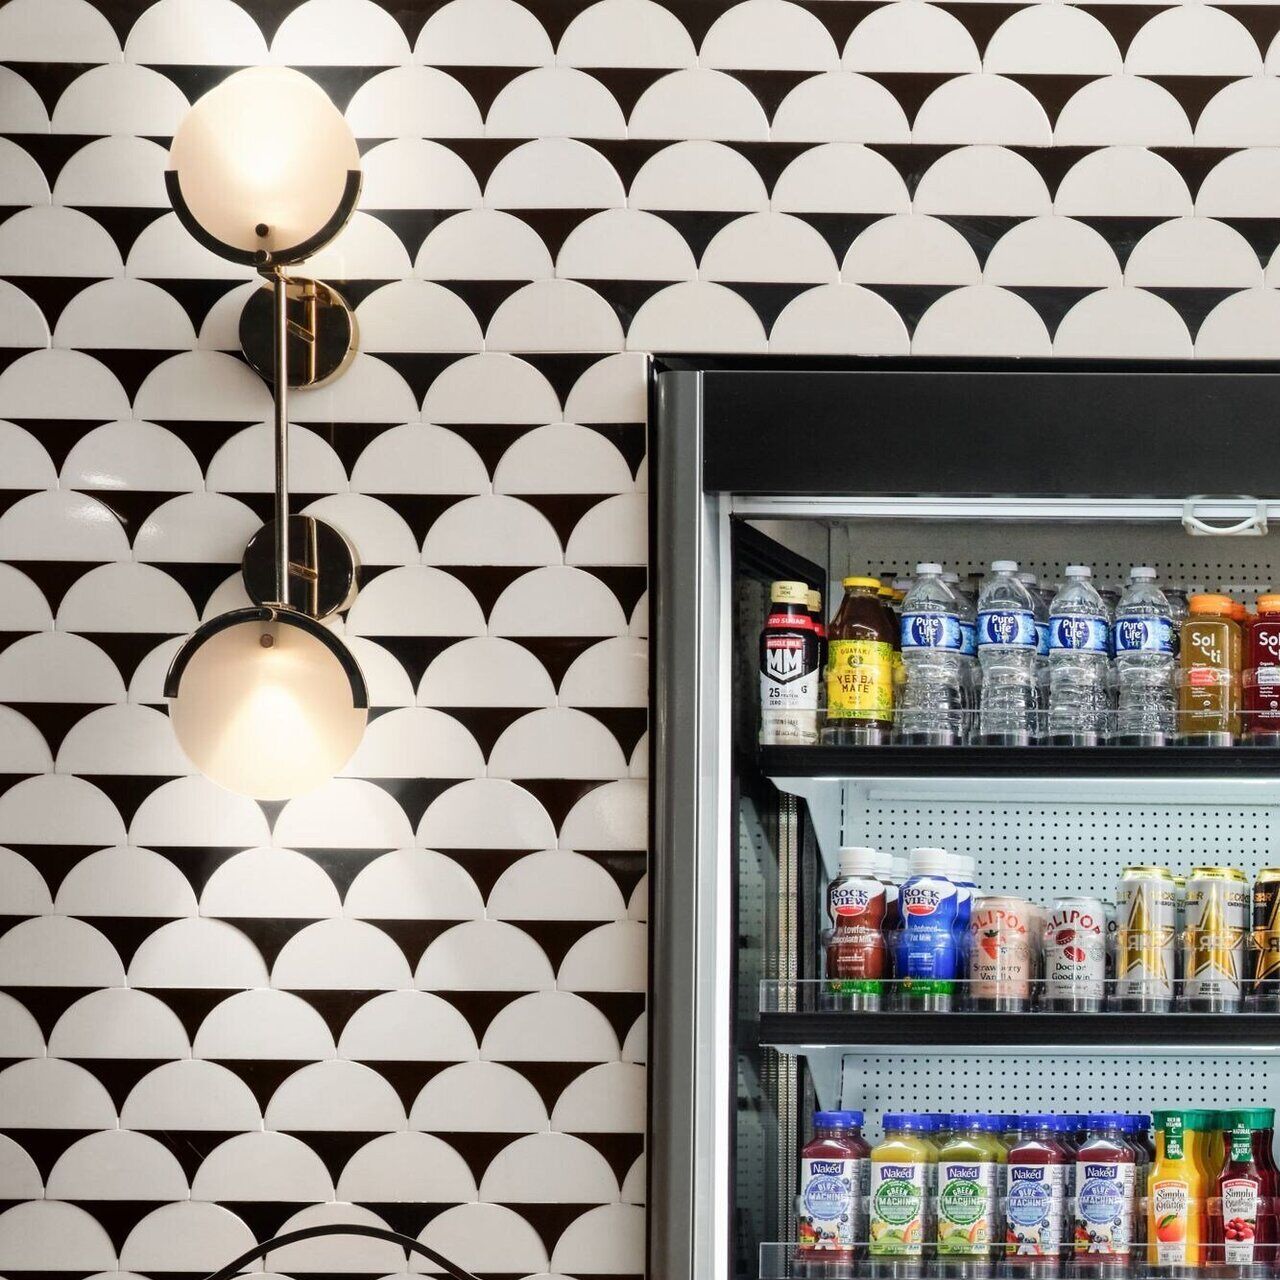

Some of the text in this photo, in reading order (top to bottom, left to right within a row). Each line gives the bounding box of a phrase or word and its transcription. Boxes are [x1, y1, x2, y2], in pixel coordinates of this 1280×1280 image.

[916, 616, 939, 628] Pure
[991, 615, 1014, 627] Pure
[1062, 620, 1085, 633] Pure
[1123, 621, 1143, 633] Pure
[1192, 632, 1215, 646] Sol
[767, 649, 802, 680] MM
[837, 675, 874, 684] YERBA
[769, 688, 780, 697] 25
[841, 684, 870, 693] MATE
[831, 889, 868, 898] ROCK
[903, 888, 940, 898] ROCK
[831, 897, 869, 906] VIEW
[903, 896, 940, 906] VIEW
[1056, 962, 1087, 972] Doctor
